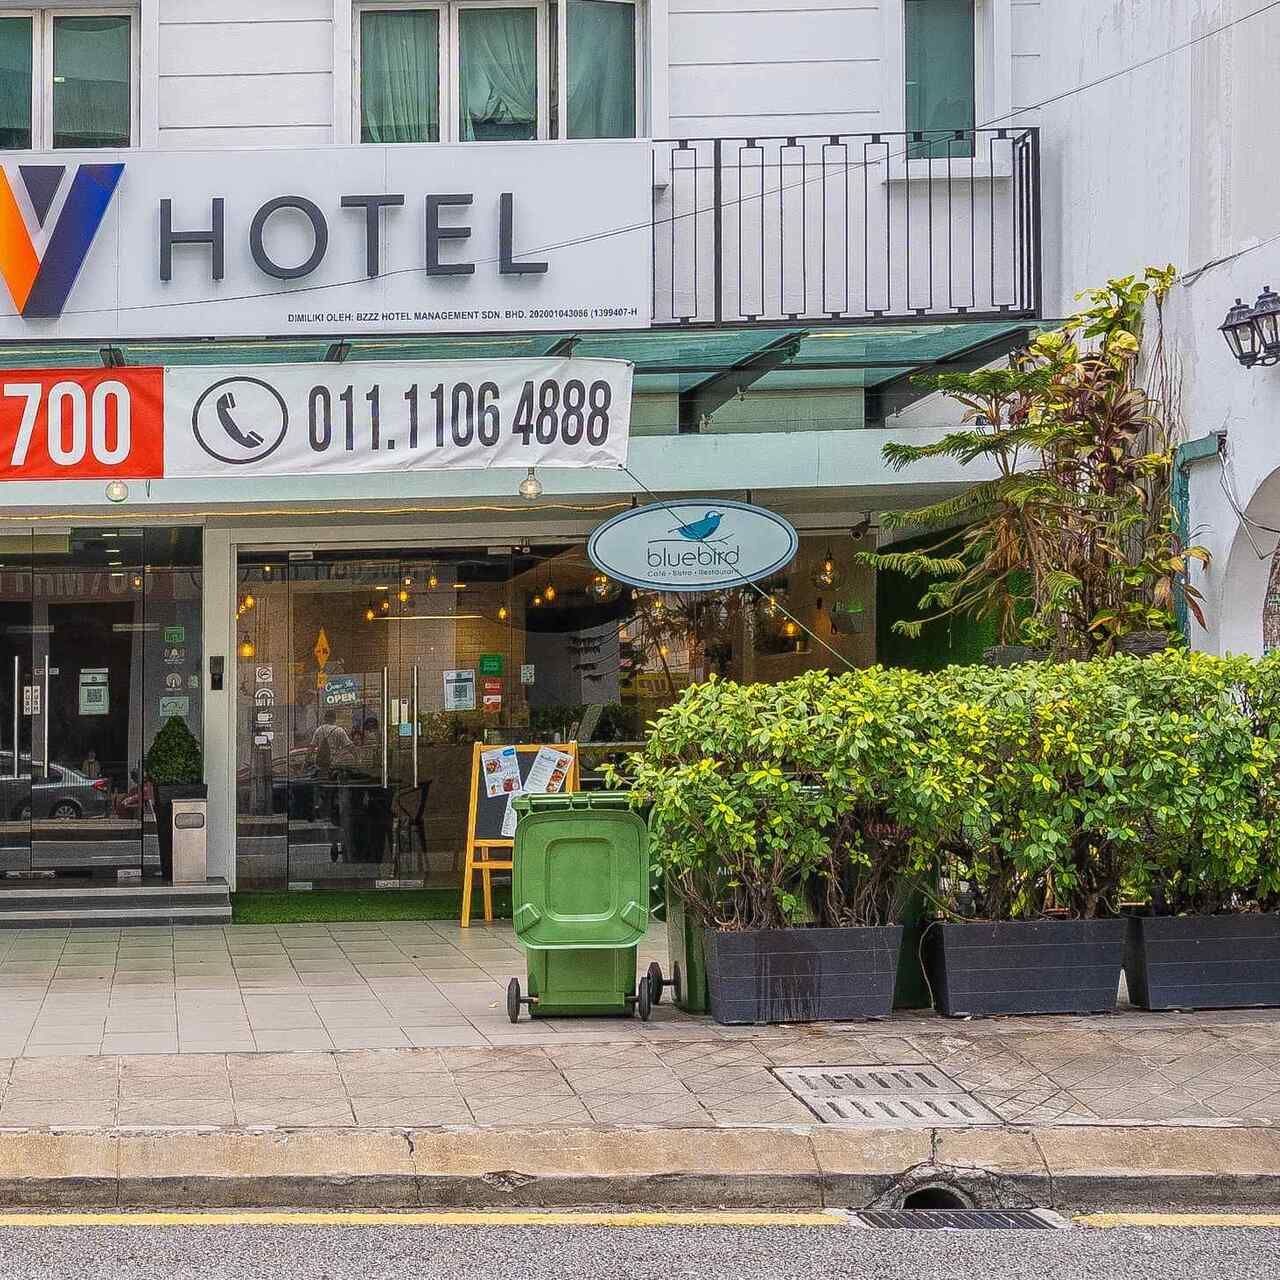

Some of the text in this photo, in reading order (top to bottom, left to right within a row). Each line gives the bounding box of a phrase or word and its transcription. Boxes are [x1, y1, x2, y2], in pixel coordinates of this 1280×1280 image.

[159, 193, 549, 281] HOTEL
[287, 313, 324, 323] DIMILIKI
[326, 312, 354, 322] OLEH:
[381, 311, 411, 321] HOTEL
[413, 310, 479, 321] MANAGEMENT
[505, 310, 527, 319] BHD.
[512, 378, 612, 447] 4888
[647, 545, 740, 568] bluebird
